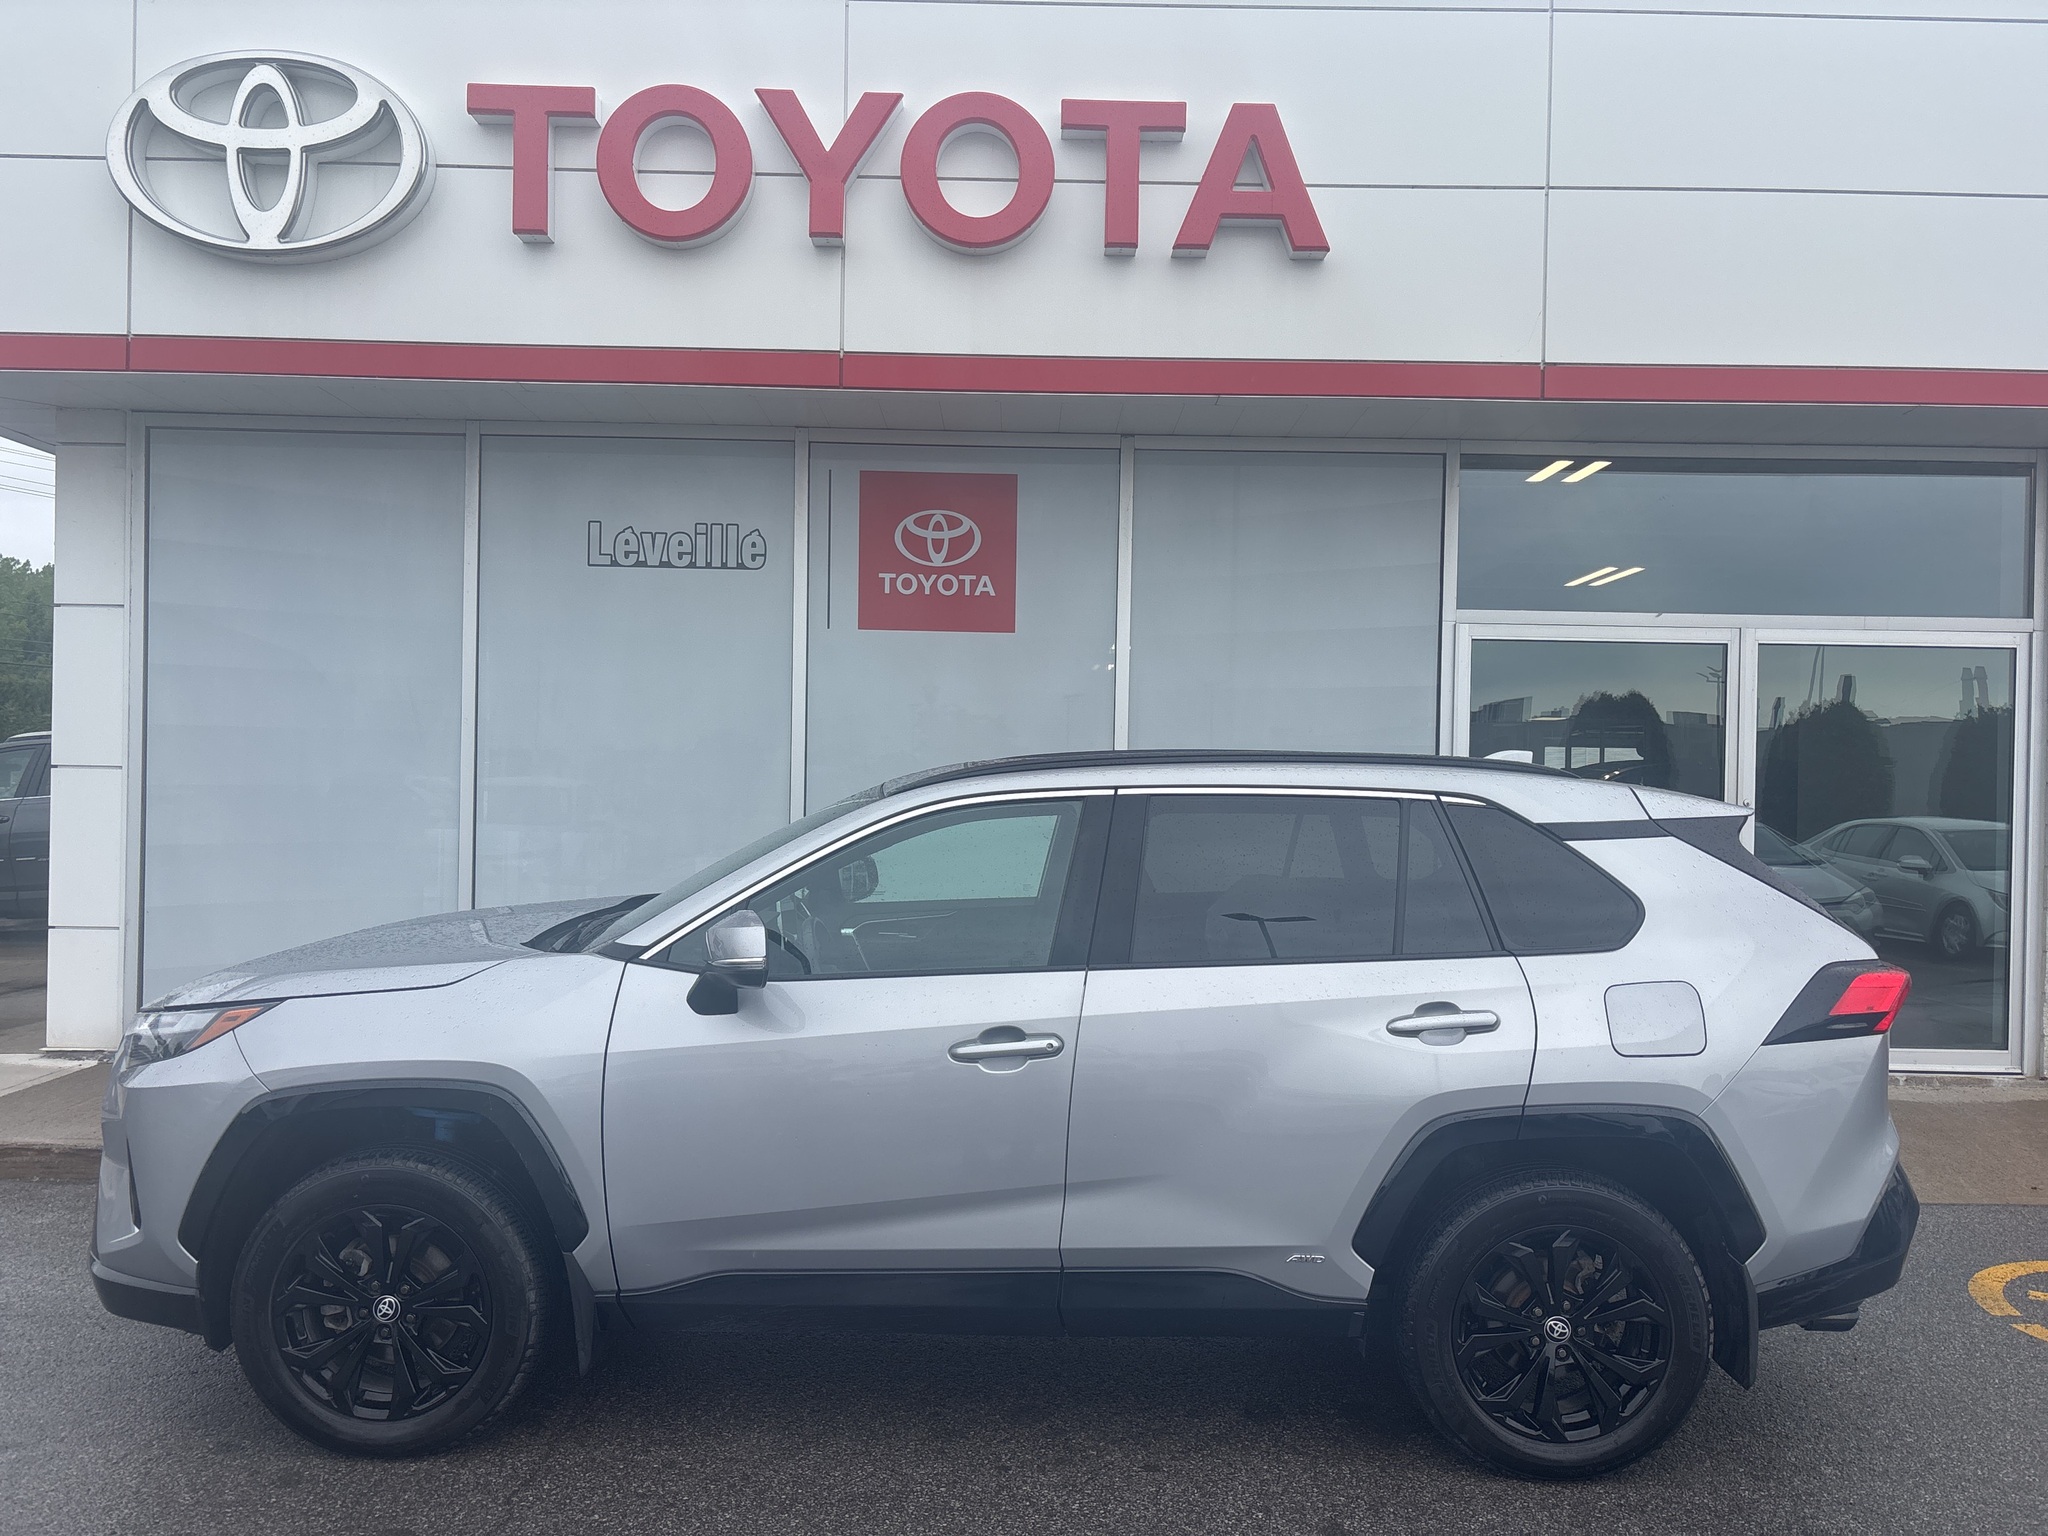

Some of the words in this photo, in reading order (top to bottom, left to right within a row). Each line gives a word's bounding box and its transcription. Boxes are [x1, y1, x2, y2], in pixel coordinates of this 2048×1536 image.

[467, 83, 1331, 254] TOYOTA
[588, 521, 766, 570] Léveillé
[878, 572, 996, 596] TOYOTA
[1285, 1253, 1326, 1263] AWD
